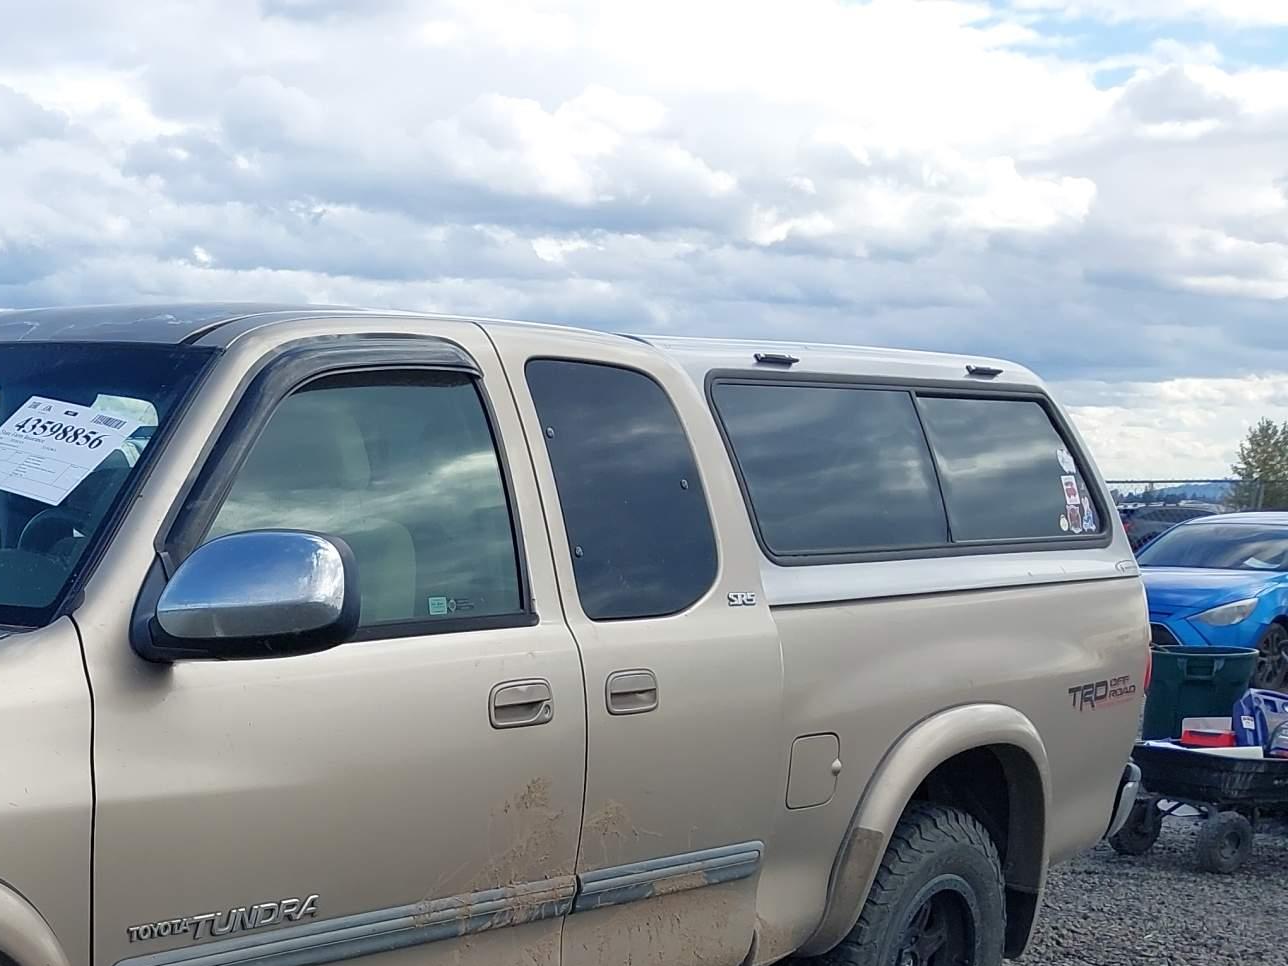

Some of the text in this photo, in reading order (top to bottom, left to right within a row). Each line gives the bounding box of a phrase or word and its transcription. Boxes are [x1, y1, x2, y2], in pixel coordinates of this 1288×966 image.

[15, 416, 110, 450] 43598856
[727, 591, 756, 607] SR5
[1068, 674, 1130, 712] TRD OFF
[1109, 684, 1136, 698] ROAD
[127, 893, 320, 943] TOYOTA TUNDRA
